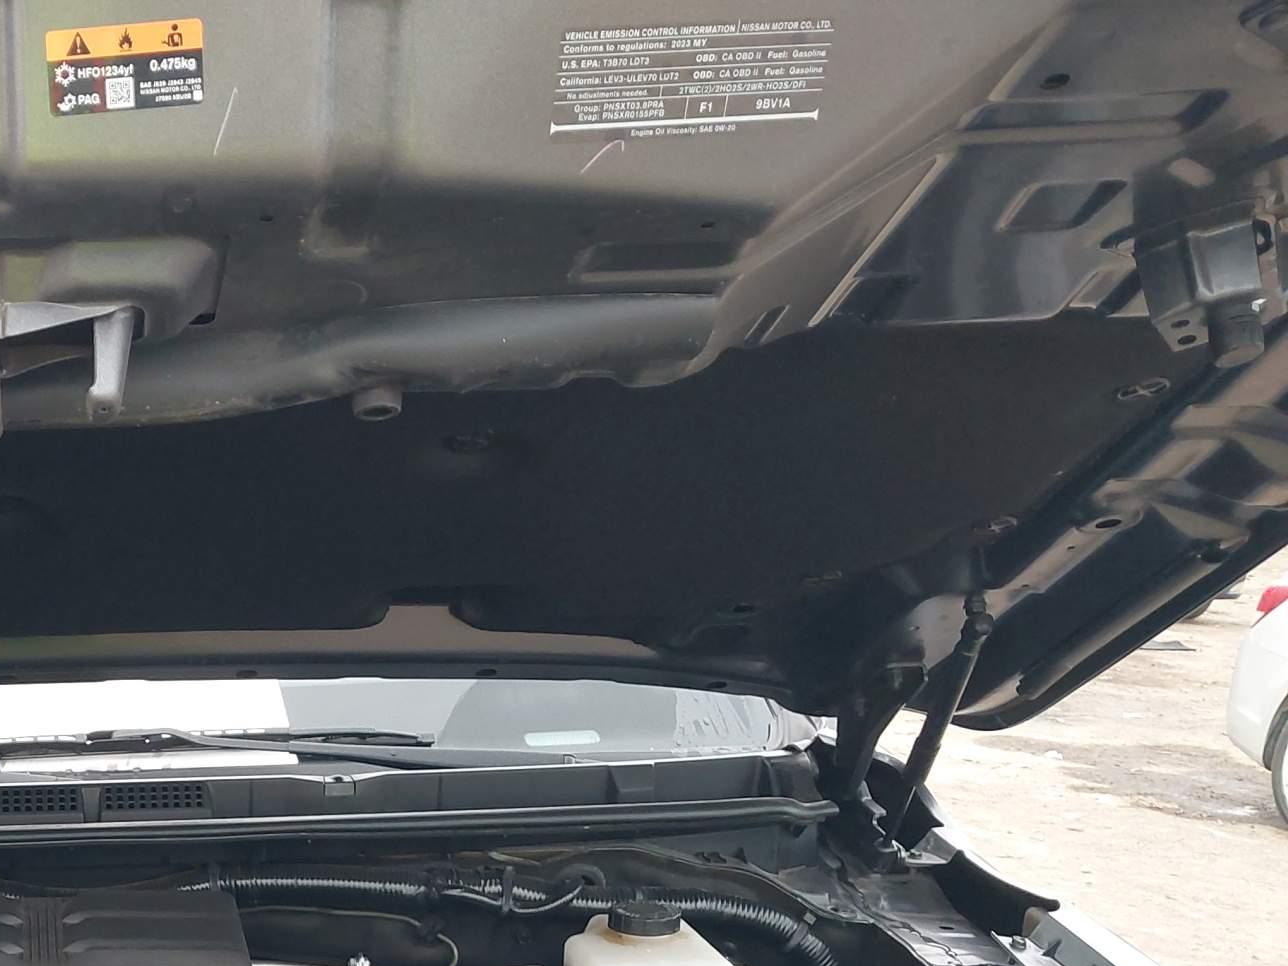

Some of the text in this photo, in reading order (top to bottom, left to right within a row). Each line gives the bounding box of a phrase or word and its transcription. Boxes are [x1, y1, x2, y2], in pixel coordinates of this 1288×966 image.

[741, 22, 770, 31] NISSAN
[771, 21, 799, 30] MOTOR
[816, 20, 832, 28] LTD.
[565, 24, 735, 40] VEHICLE EMISSION CONTROL INFORMATION
[563, 38, 707, 53] Conforms to regulations: 2023 MY
[696, 54, 717, 62] OBD:
[722, 53, 733, 61] CA
[735, 52, 754, 60] OBD
[768, 50, 788, 59] Fuel:
[792, 49, 826, 58] Gasoline
[149, 57, 197, 72] 0.475kg
[562, 57, 650, 69] U.S. EPA: T3B70 LDT3
[78, 64, 134, 78] HFO1234yf
[693, 71, 715, 79] OBD:
[719, 70, 730, 78] CA
[733, 69, 751, 77] OBD
[764, 67, 785, 76] Fuel:
[789, 66, 823, 75] Gasoline
[560, 72, 679, 86] California: LEV3-ULEV70 LDT2
[78, 93, 101, 105] PAG
[566, 89, 648, 100] No adjustments needed.
[574, 104, 601, 113] Group:
[699, 101, 713, 112] F1
[755, 97, 791, 110] 9BV1A
[578, 113, 600, 122] Evap:
[630, 128, 654, 137] Engine
[655, 127, 665, 135] Oil
[666, 125, 697, 136] Viscosity:
[699, 125, 714, 133] SAE
